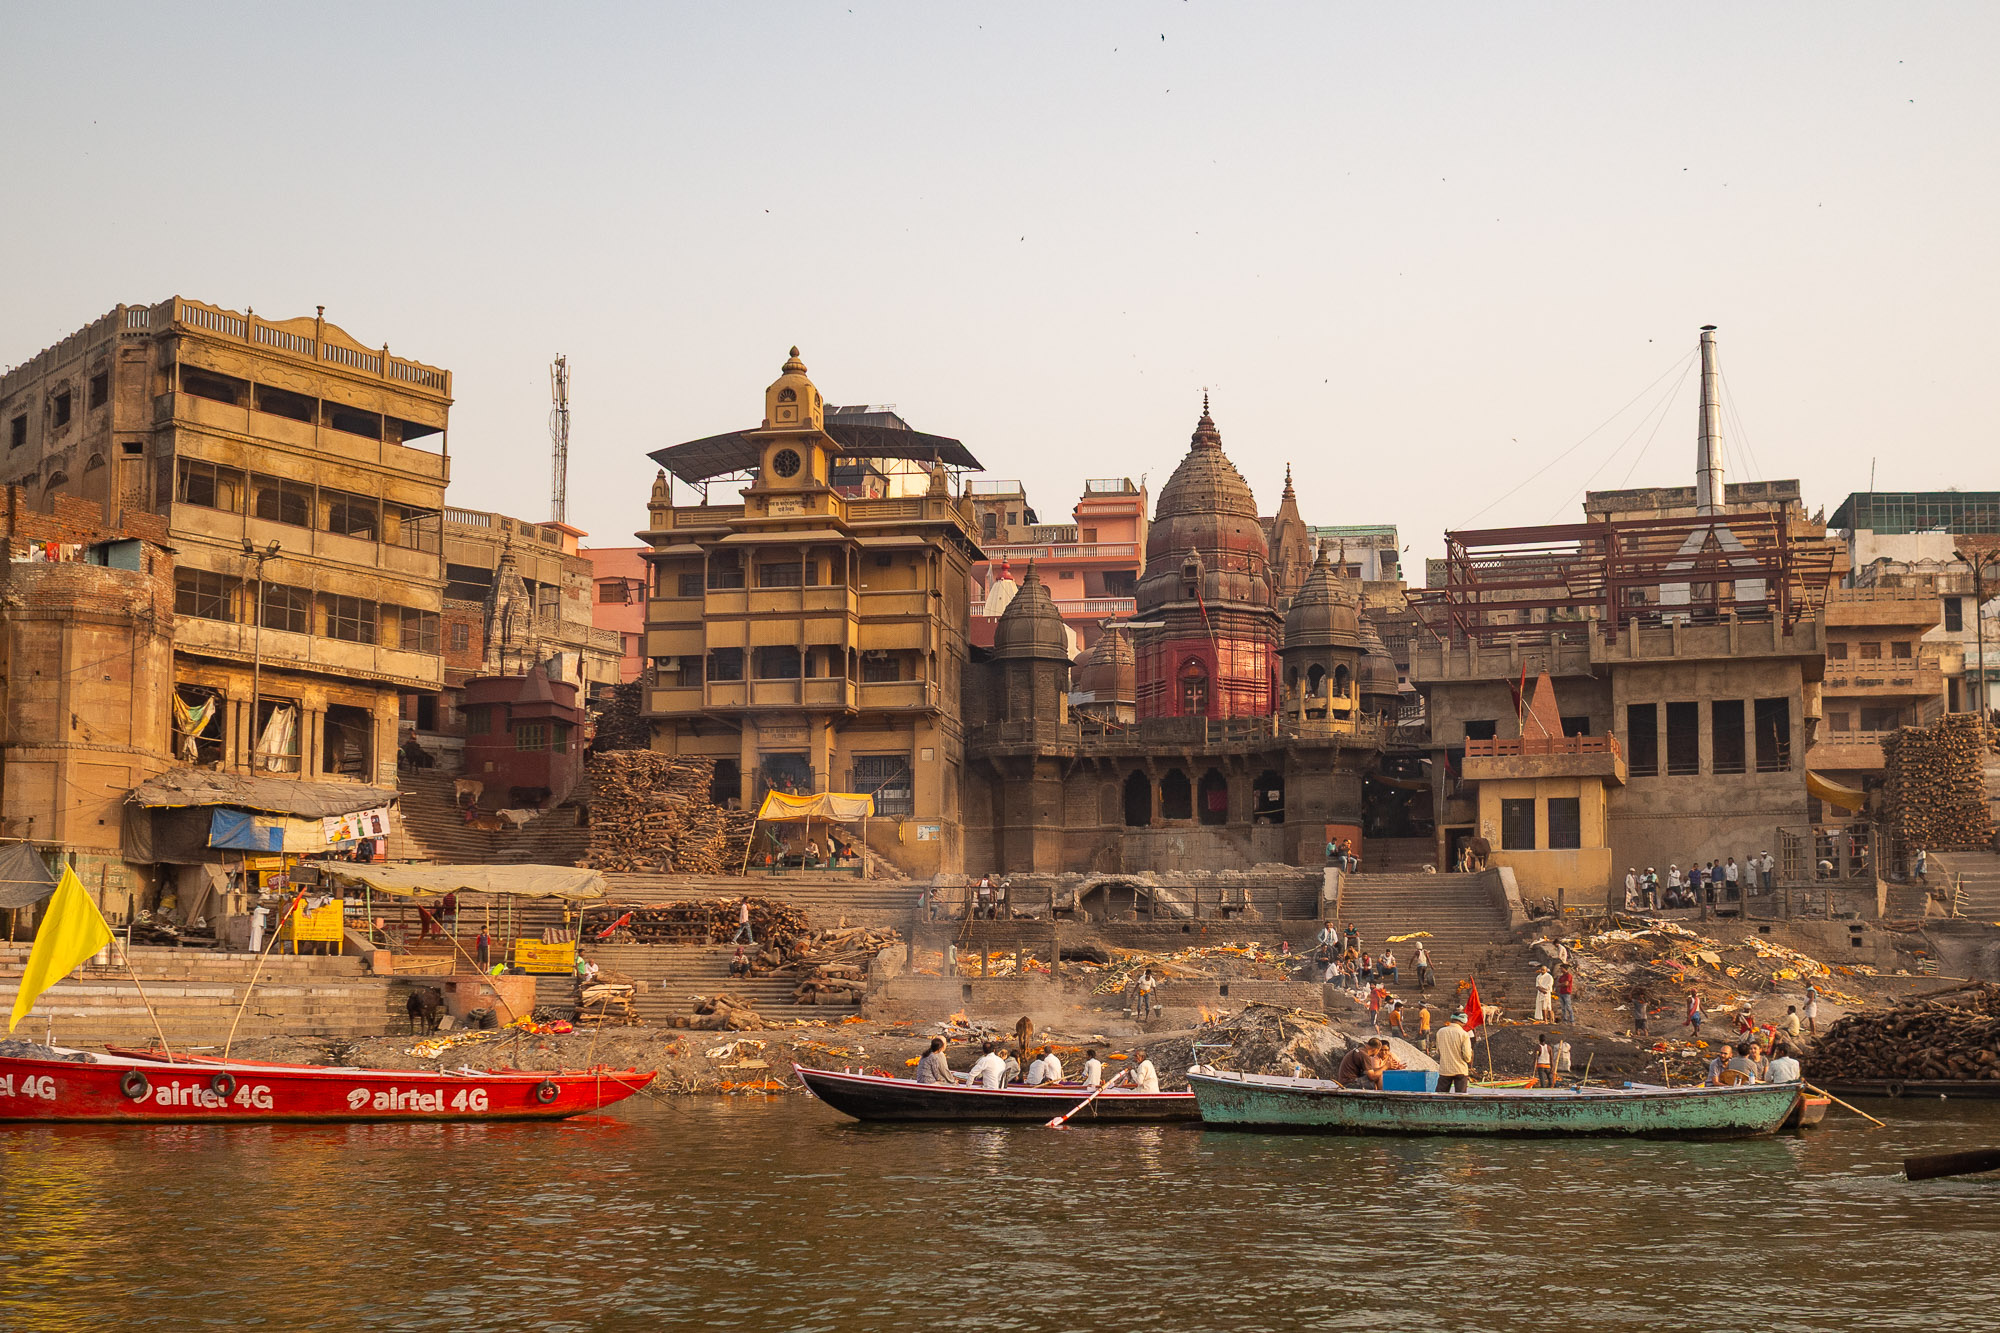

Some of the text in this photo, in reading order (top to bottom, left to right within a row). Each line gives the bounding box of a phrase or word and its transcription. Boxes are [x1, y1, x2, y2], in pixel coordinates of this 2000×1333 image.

[21, 1075, 56, 1100] 4G
[156, 1081, 273, 1109] airtel 4G
[373, 1087, 489, 1112] airtel 4G
